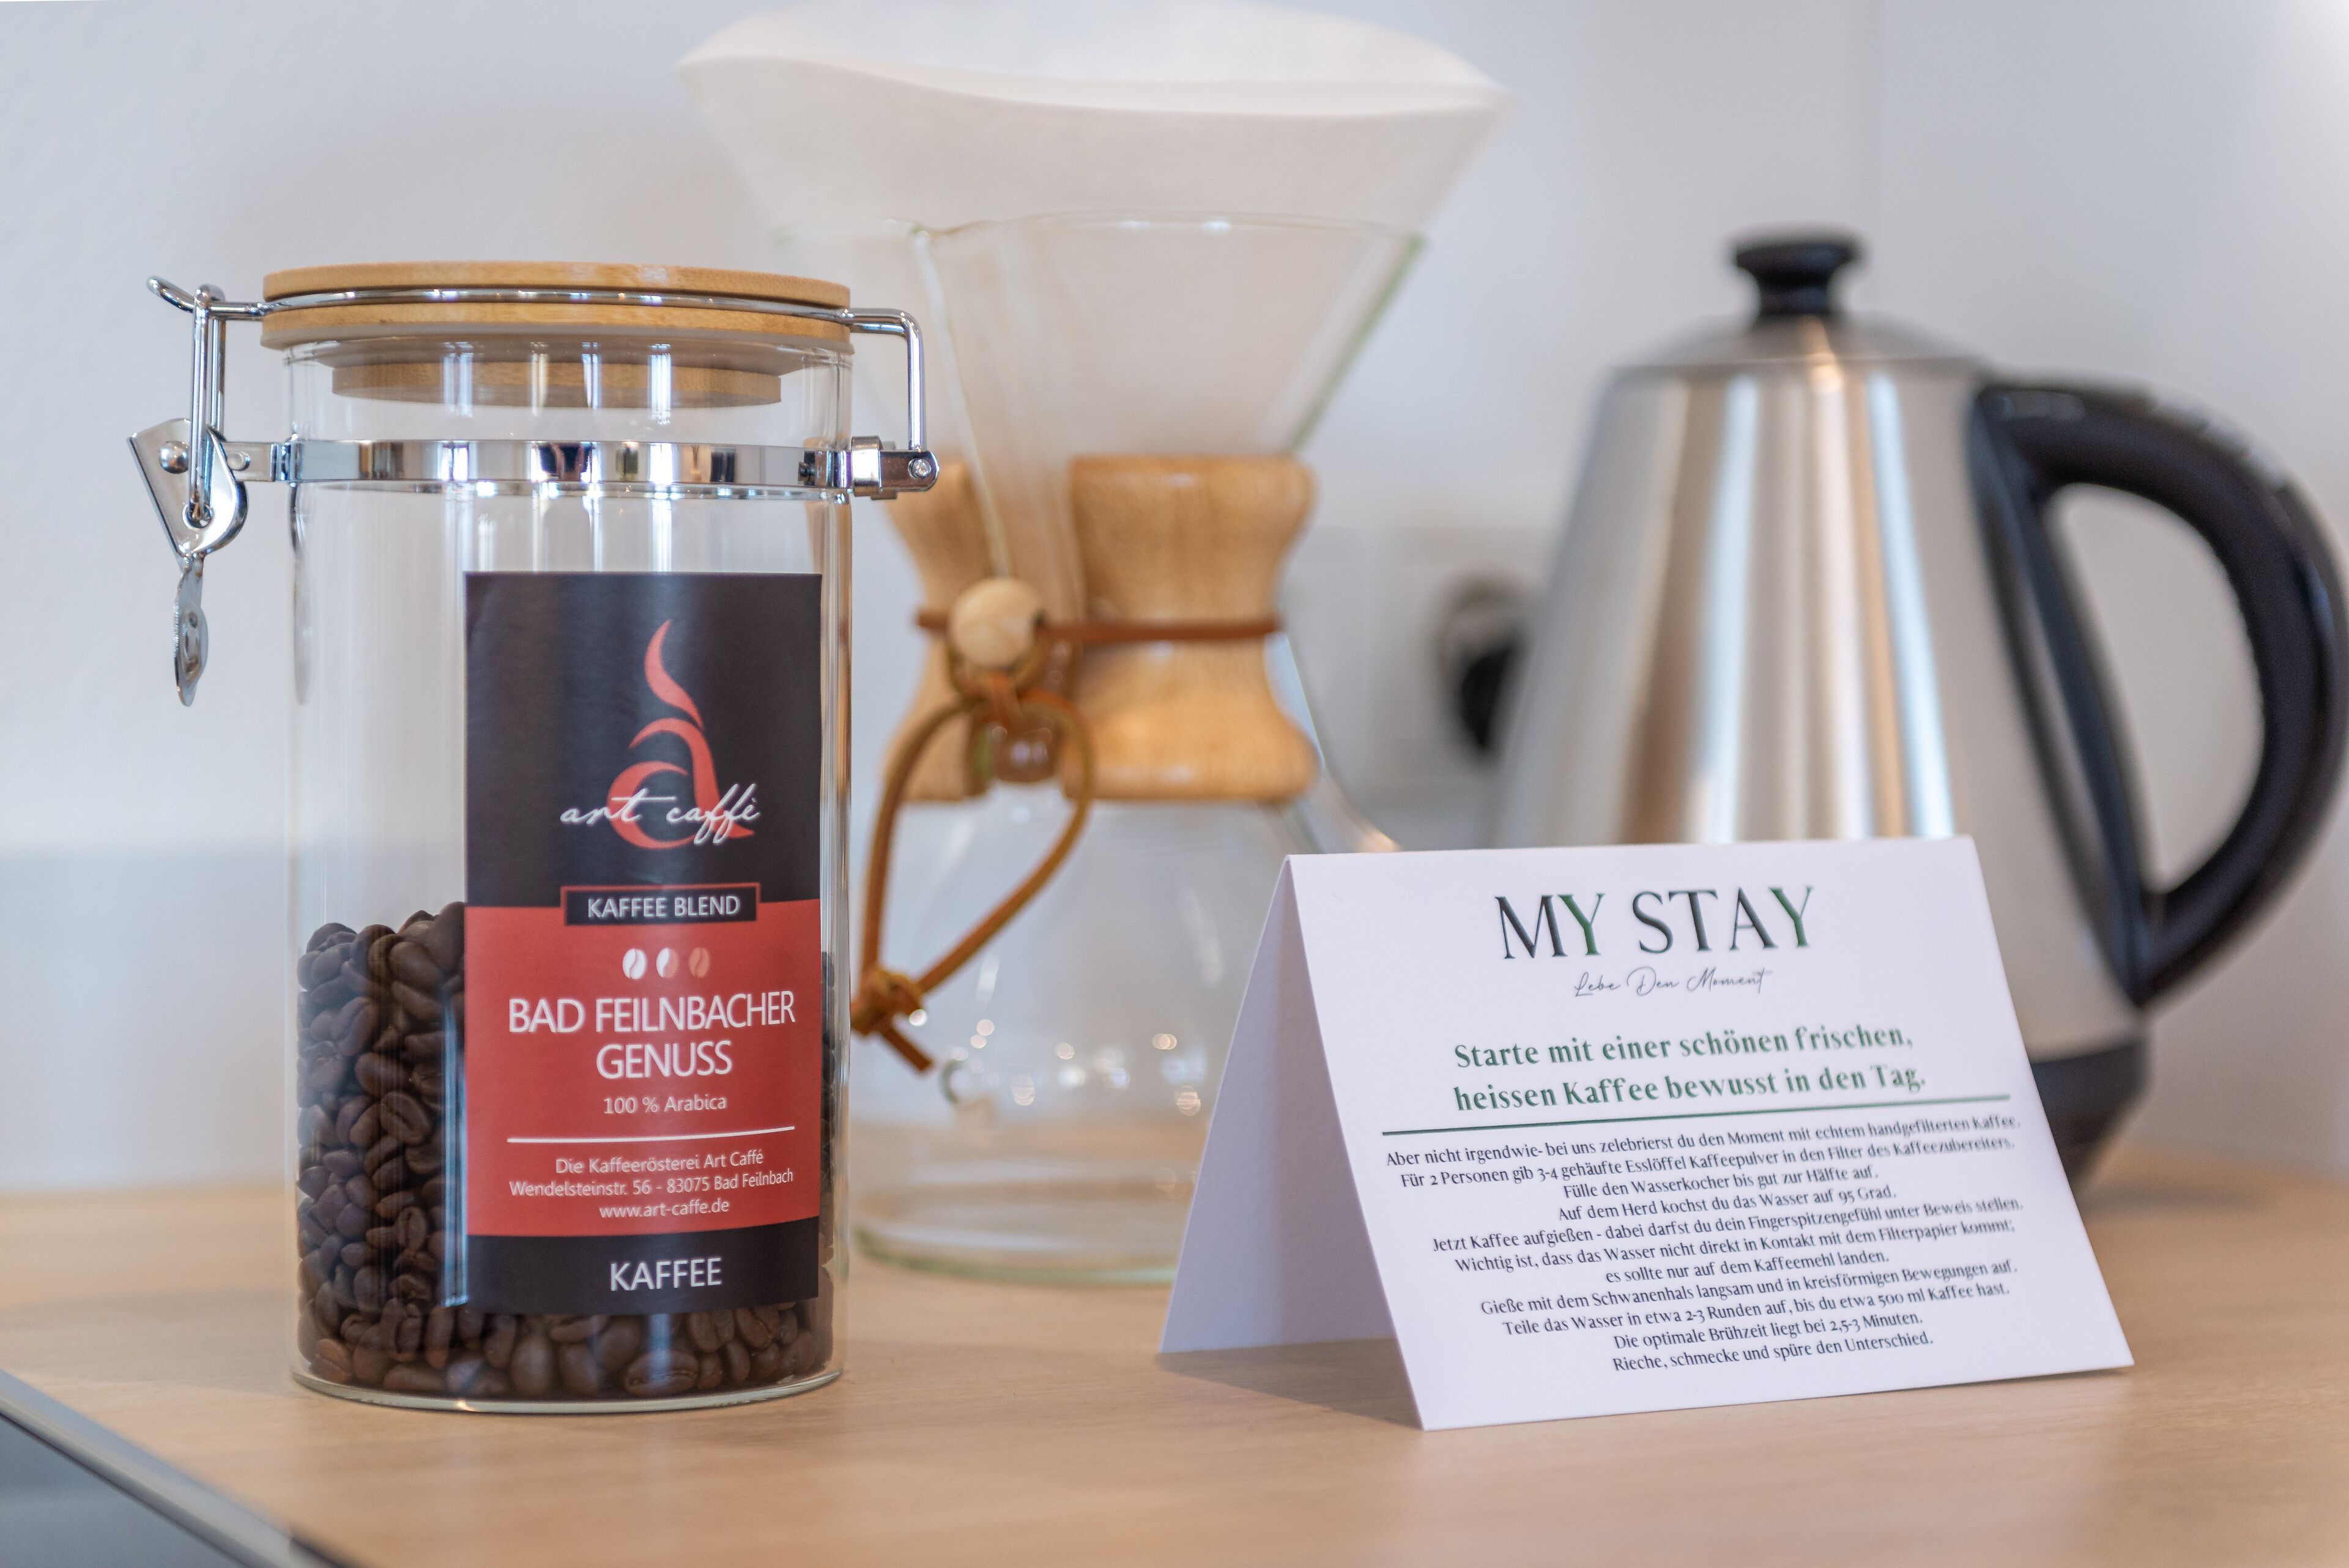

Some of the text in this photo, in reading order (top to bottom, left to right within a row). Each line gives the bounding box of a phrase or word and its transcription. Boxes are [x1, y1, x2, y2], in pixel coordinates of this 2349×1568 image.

[560, 787, 676, 824] art
[588, 896, 740, 918] KAFFEE BLEND
[1496, 886, 1812, 958] MY STAY
[1574, 966, 1773, 997] Lebe Den Moment
[509, 990, 795, 1032] BAD FEILNBACHER
[596, 1041, 732, 1079] GENUSS
[1454, 1024, 1912, 1068] Starte mit einer schönen frischen,
[603, 1094, 726, 1113] 100 % Arabica
[1453, 1065, 1925, 1110] heissen Kaffee bewusst in den Tag.
[1387, 1152, 1420, 1165] Aber
[1425, 1148, 1463, 1163] nicht
[1464, 1144, 1543, 1164] irgendwie-
[1545, 1142, 1568, 1156] bei
[1571, 1143, 1596, 1154] uns
[1600, 1137, 1674, 1152] zelebrierst
[1677, 1134, 1695, 1148] du
[1698, 1133, 1724, 1146] den
[1727, 1130, 1785, 1144] Moment
[1788, 1127, 1811, 1141] mit
[1815, 1125, 1866, 1140] echtem
[1866, 1119, 1970, 1139] handgefilterten
[556, 1149, 763, 1173] Die Kaffeerösterei Art Caffé
[1400, 1173, 1424, 1187] Für
[1430, 1175, 1438, 1185] 2
[1440, 1170, 1509, 1184] Personen
[1512, 1166, 1533, 1184] gib
[1537, 1168, 1558, 1181] 3-4
[1561, 1161, 1622, 1181] gehäufte
[1625, 1156, 1687, 1172] Esslöffel
[1688, 1151, 1778, 1169] Kaffeepulver
[1782, 1150, 1796, 1162] in
[1799, 1148, 1825, 1162] den
[1827, 1146, 1862, 1160] Filter
[1866, 1144, 1890, 1157] des
[510, 1180, 626, 1196] Wendelsteinstr.
[633, 1180, 650, 1194] 56
[667, 1177, 708, 1194] 83075
[714, 1174, 738, 1190] Bad
[743, 1168, 793, 1187] Feilnbach
[1562, 1165, 1878, 1198] Fülle den Wasserkocher bis gut zur Hälfte auf.
[599, 1198, 729, 1218] www.art-caffe.de
[1559, 1184, 1896, 1220] Auf dem Herd kochst du das Wasser auf 95 Grad.
[1433, 1238, 1468, 1251] Jetzt
[1469, 1233, 1520, 1249] Kaffee
[1523, 1228, 1594, 1247] aufgießen
[1605, 1224, 1644, 1239] dabei
[1647, 1221, 1690, 1236] darfst
[1693, 1220, 1712, 1233] du
[1715, 1217, 1746, 1232] dein
[1748, 1206, 1882, 1232] Fingerspitzengefühl
[1884, 1206, 1920, 1219] unter
[1923, 1200, 1972, 1217] Beweis
[1975, 1197, 2023, 1213] stellen.
[1455, 1256, 1513, 1273] Wichtig
[1515, 1254, 1538, 1268] ist,
[1542, 1252, 1573, 1265] dass
[1576, 1249, 1601, 1263] das
[1603, 1248, 1655, 1260] Wasser
[1660, 1243, 1696, 1257] nicht
[1699, 1239, 1741, 1254] direkt
[1743, 1238, 1757, 1251] in
[1759, 1233, 1816, 1250] Kontakt
[1818, 1232, 1842, 1246] mit
[1846, 1230, 1877, 1244] dem
[1878, 1224, 1957, 1242] Filterpapier
[1605, 1250, 1889, 1282] es sollte nur auf dem Kaffeemehl landen.
[610, 1258, 722, 1291] KAFFEE
[1480, 1259, 2017, 1314] Gieße mit dem Schwanenhals langsam und in kreisförmigen Bewegungen auf.
[1502, 1283, 2009, 1334] Teile das Wasser in etwa 2-3 Runden auf, bis du etwa 500 ml Kaffee hast.
[1613, 1313, 1923, 1349] Die optimale Brühzeit liegt bei 2,5-3 Minuten.
[1612, 1331, 1933, 1370] Rieche, schmecke und spüre den Unterschied.
